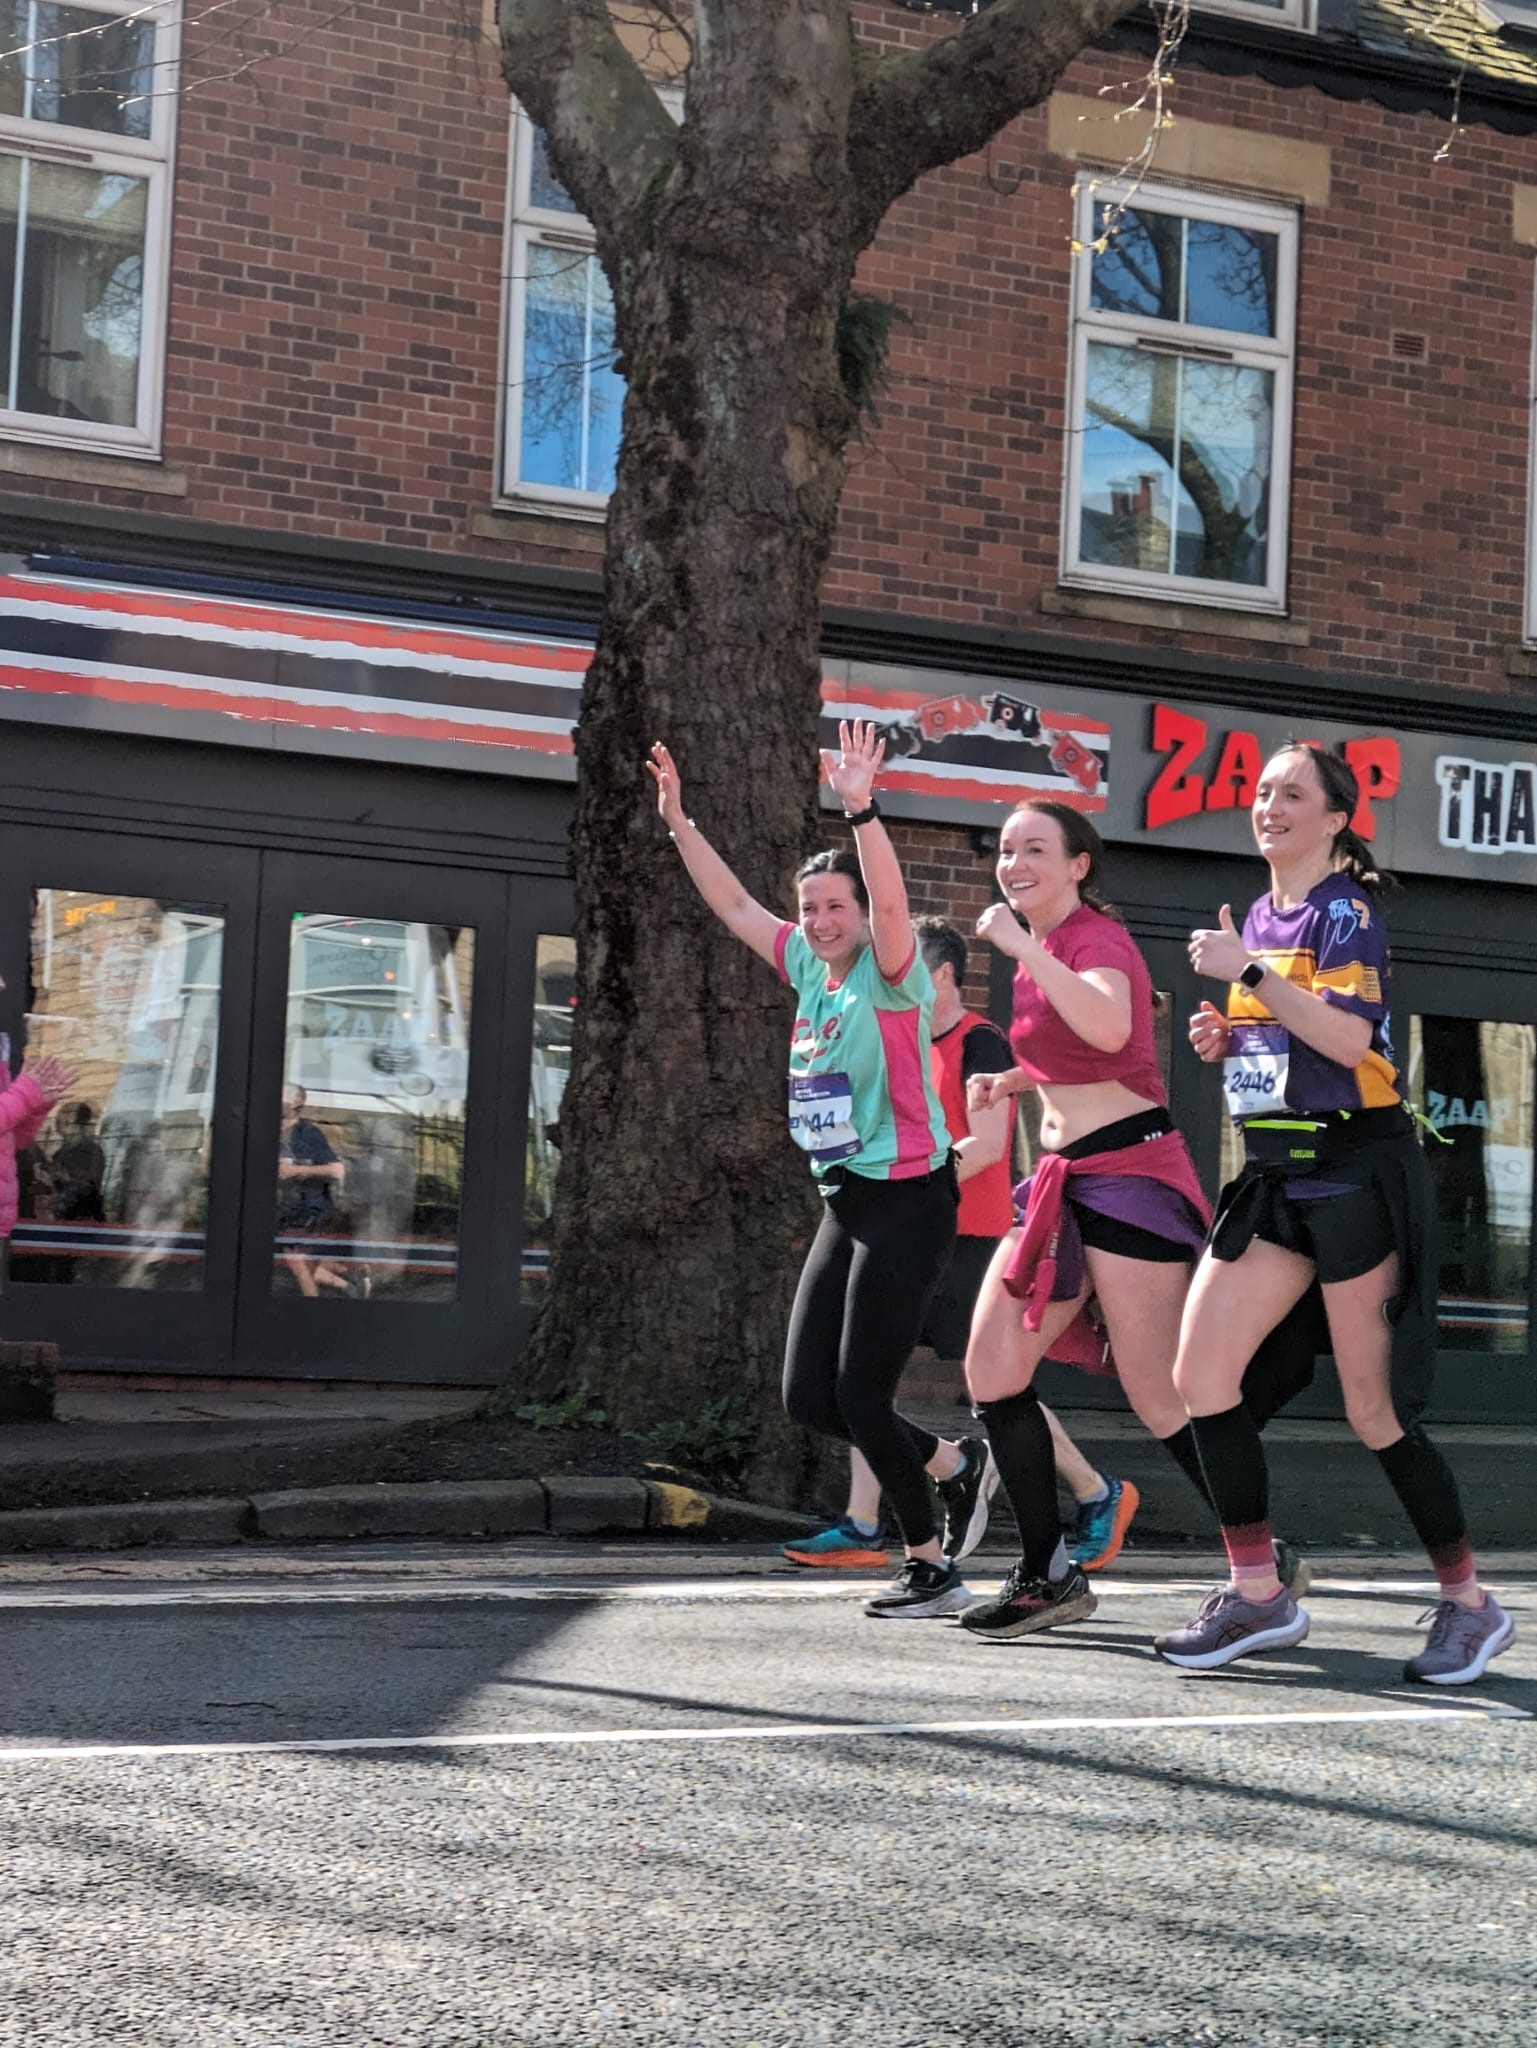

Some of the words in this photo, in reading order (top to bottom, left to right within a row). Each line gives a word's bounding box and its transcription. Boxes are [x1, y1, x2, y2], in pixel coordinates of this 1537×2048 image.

[1145, 703, 1401, 841] ZAP
[1228, 1070, 1277, 1094] 2446
[1427, 1088, 1511, 1133] ZAAP
